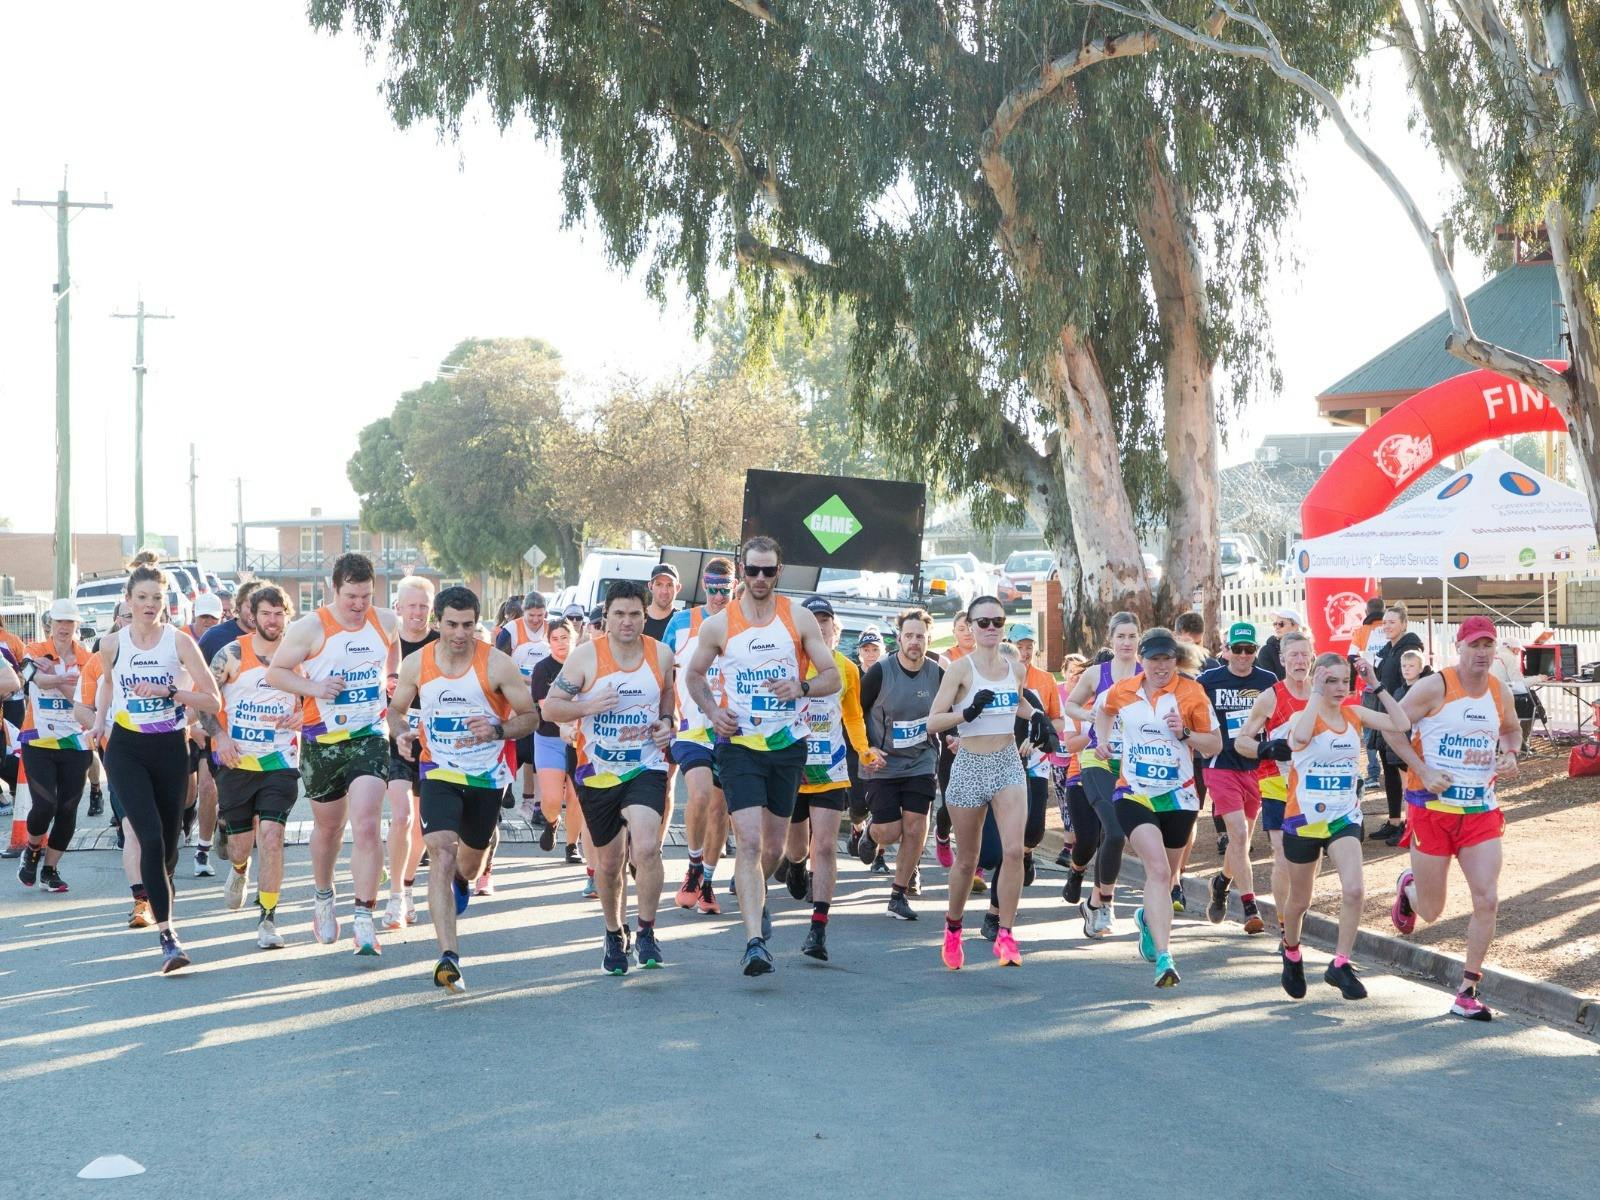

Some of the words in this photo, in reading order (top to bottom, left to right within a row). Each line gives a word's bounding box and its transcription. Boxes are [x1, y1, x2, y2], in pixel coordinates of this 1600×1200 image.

[1482, 383, 1549, 420] FIN
[811, 514, 854, 535] GAME
[1472, 525, 1537, 535] Disability
[1311, 552, 1350, 569] Community
[1351, 552, 1372, 569] Living
[1379, 553, 1406, 568] Respite
[1407, 552, 1439, 566] Services
[736, 665, 787, 681] Johnno's
[348, 689, 367, 703] 92
[52, 699, 64, 709] 81
[138, 698, 165, 713] 132
[236, 700, 285, 714] Johnno's
[763, 697, 787, 710] 122
[593, 711, 648, 725] Johnno's
[240, 728, 266, 742] 104
[593, 724, 617, 737] Run
[902, 726, 920, 738] 137
[1440, 733, 1489, 749] Johnno's
[607, 751, 626, 761] 76
[1129, 743, 1172, 757] Johnno's
[1438, 745, 1462, 759] Run
[1147, 765, 1168, 779] 90
[1318, 777, 1341, 790] 112
[1454, 787, 1476, 800] 119
